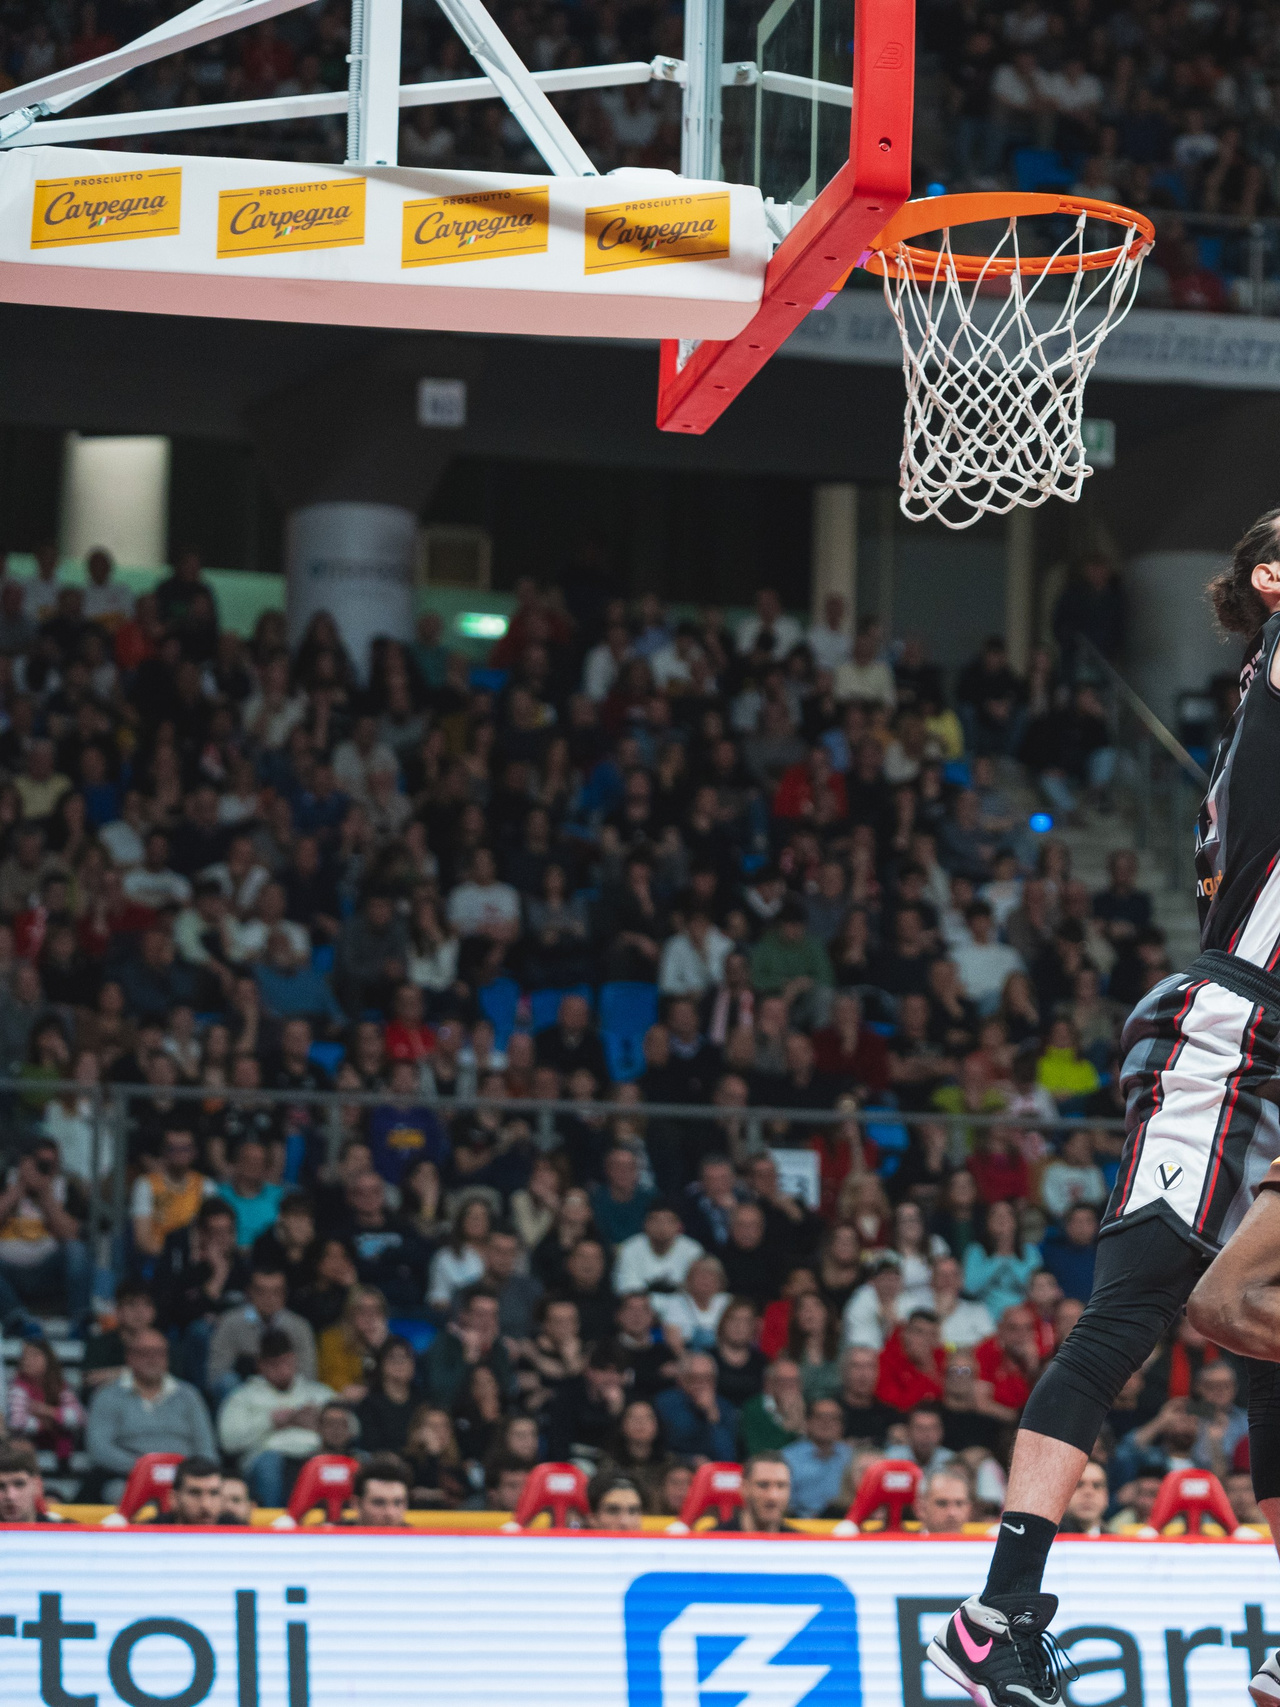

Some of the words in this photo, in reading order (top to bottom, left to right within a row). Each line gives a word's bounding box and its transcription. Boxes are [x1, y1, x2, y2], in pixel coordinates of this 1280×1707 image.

[74, 173, 143, 187] PROSCIUTTO
[259, 183, 328, 197] PROSCIUTTO
[44, 191, 168, 229] Carpegna
[443, 192, 512, 206] PROSCIUTTO
[625, 197, 692, 212] PROSCIUTTO
[230, 201, 352, 239] Carpegna
[414, 211, 537, 248] Carpegna
[597, 217, 718, 253] Carpegna
[0, 1587, 310, 1707] toli
